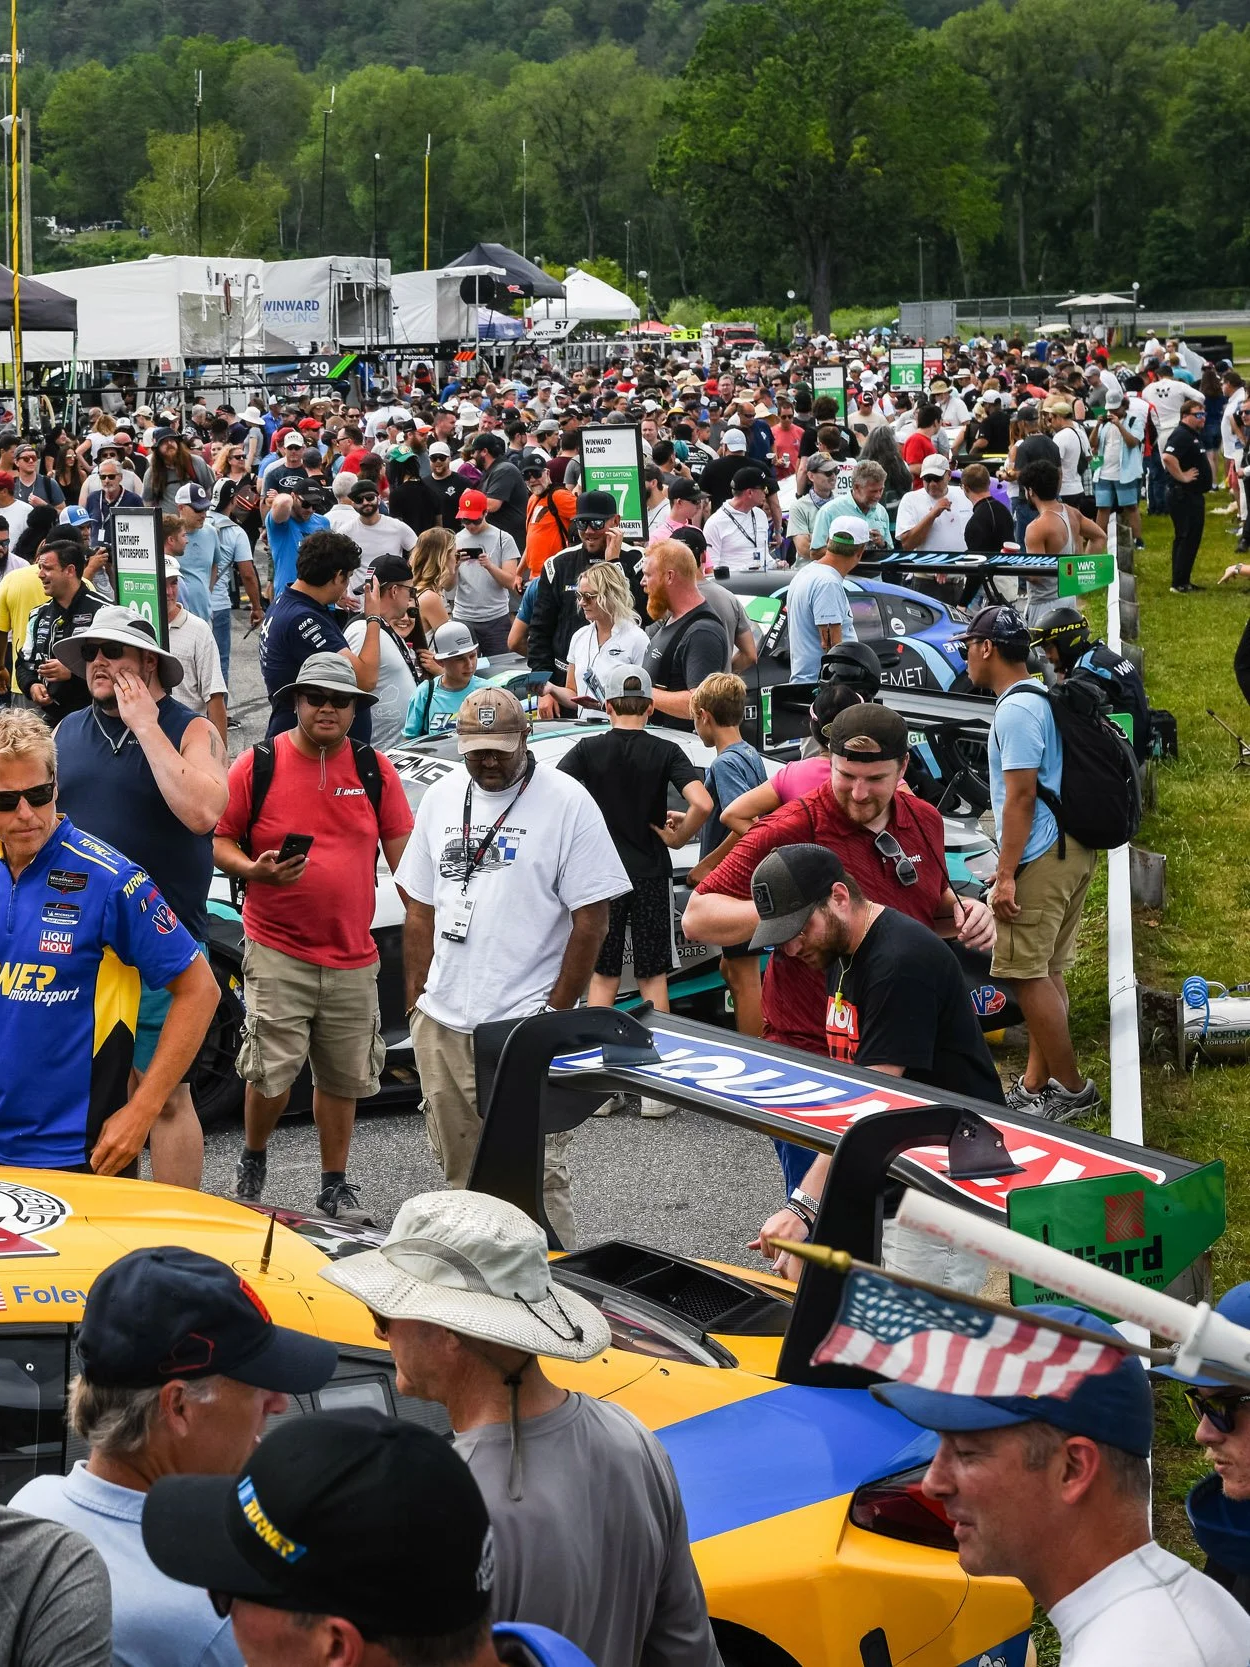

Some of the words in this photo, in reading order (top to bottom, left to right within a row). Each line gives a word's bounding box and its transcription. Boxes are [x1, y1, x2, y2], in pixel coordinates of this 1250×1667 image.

[264, 300, 320, 311] WINWARD
[264, 312, 320, 323] RACING
[549, 320, 564, 330] 57
[687, 331, 701, 340] 51
[309, 361, 330, 377] 39
[898, 369, 915, 384] 16
[585, 438, 611, 446] WINWARD
[591, 471, 605, 479] GTD
[613, 471, 632, 479] DAYTONA
[117, 522, 130, 533] TEAM
[118, 535, 140, 545] KORTHOFF
[118, 548, 149, 560] MOTORSPORTS
[773, 613, 786, 631] Ward
[151, 904, 174, 932] VP
[42, 931, 72, 943] LIQUI
[41, 941, 71, 953] MOLY
[9, 986, 80, 1007] motorsport
[970, 986, 996, 1015] VP
[243, 1496, 296, 1558] TURNER
